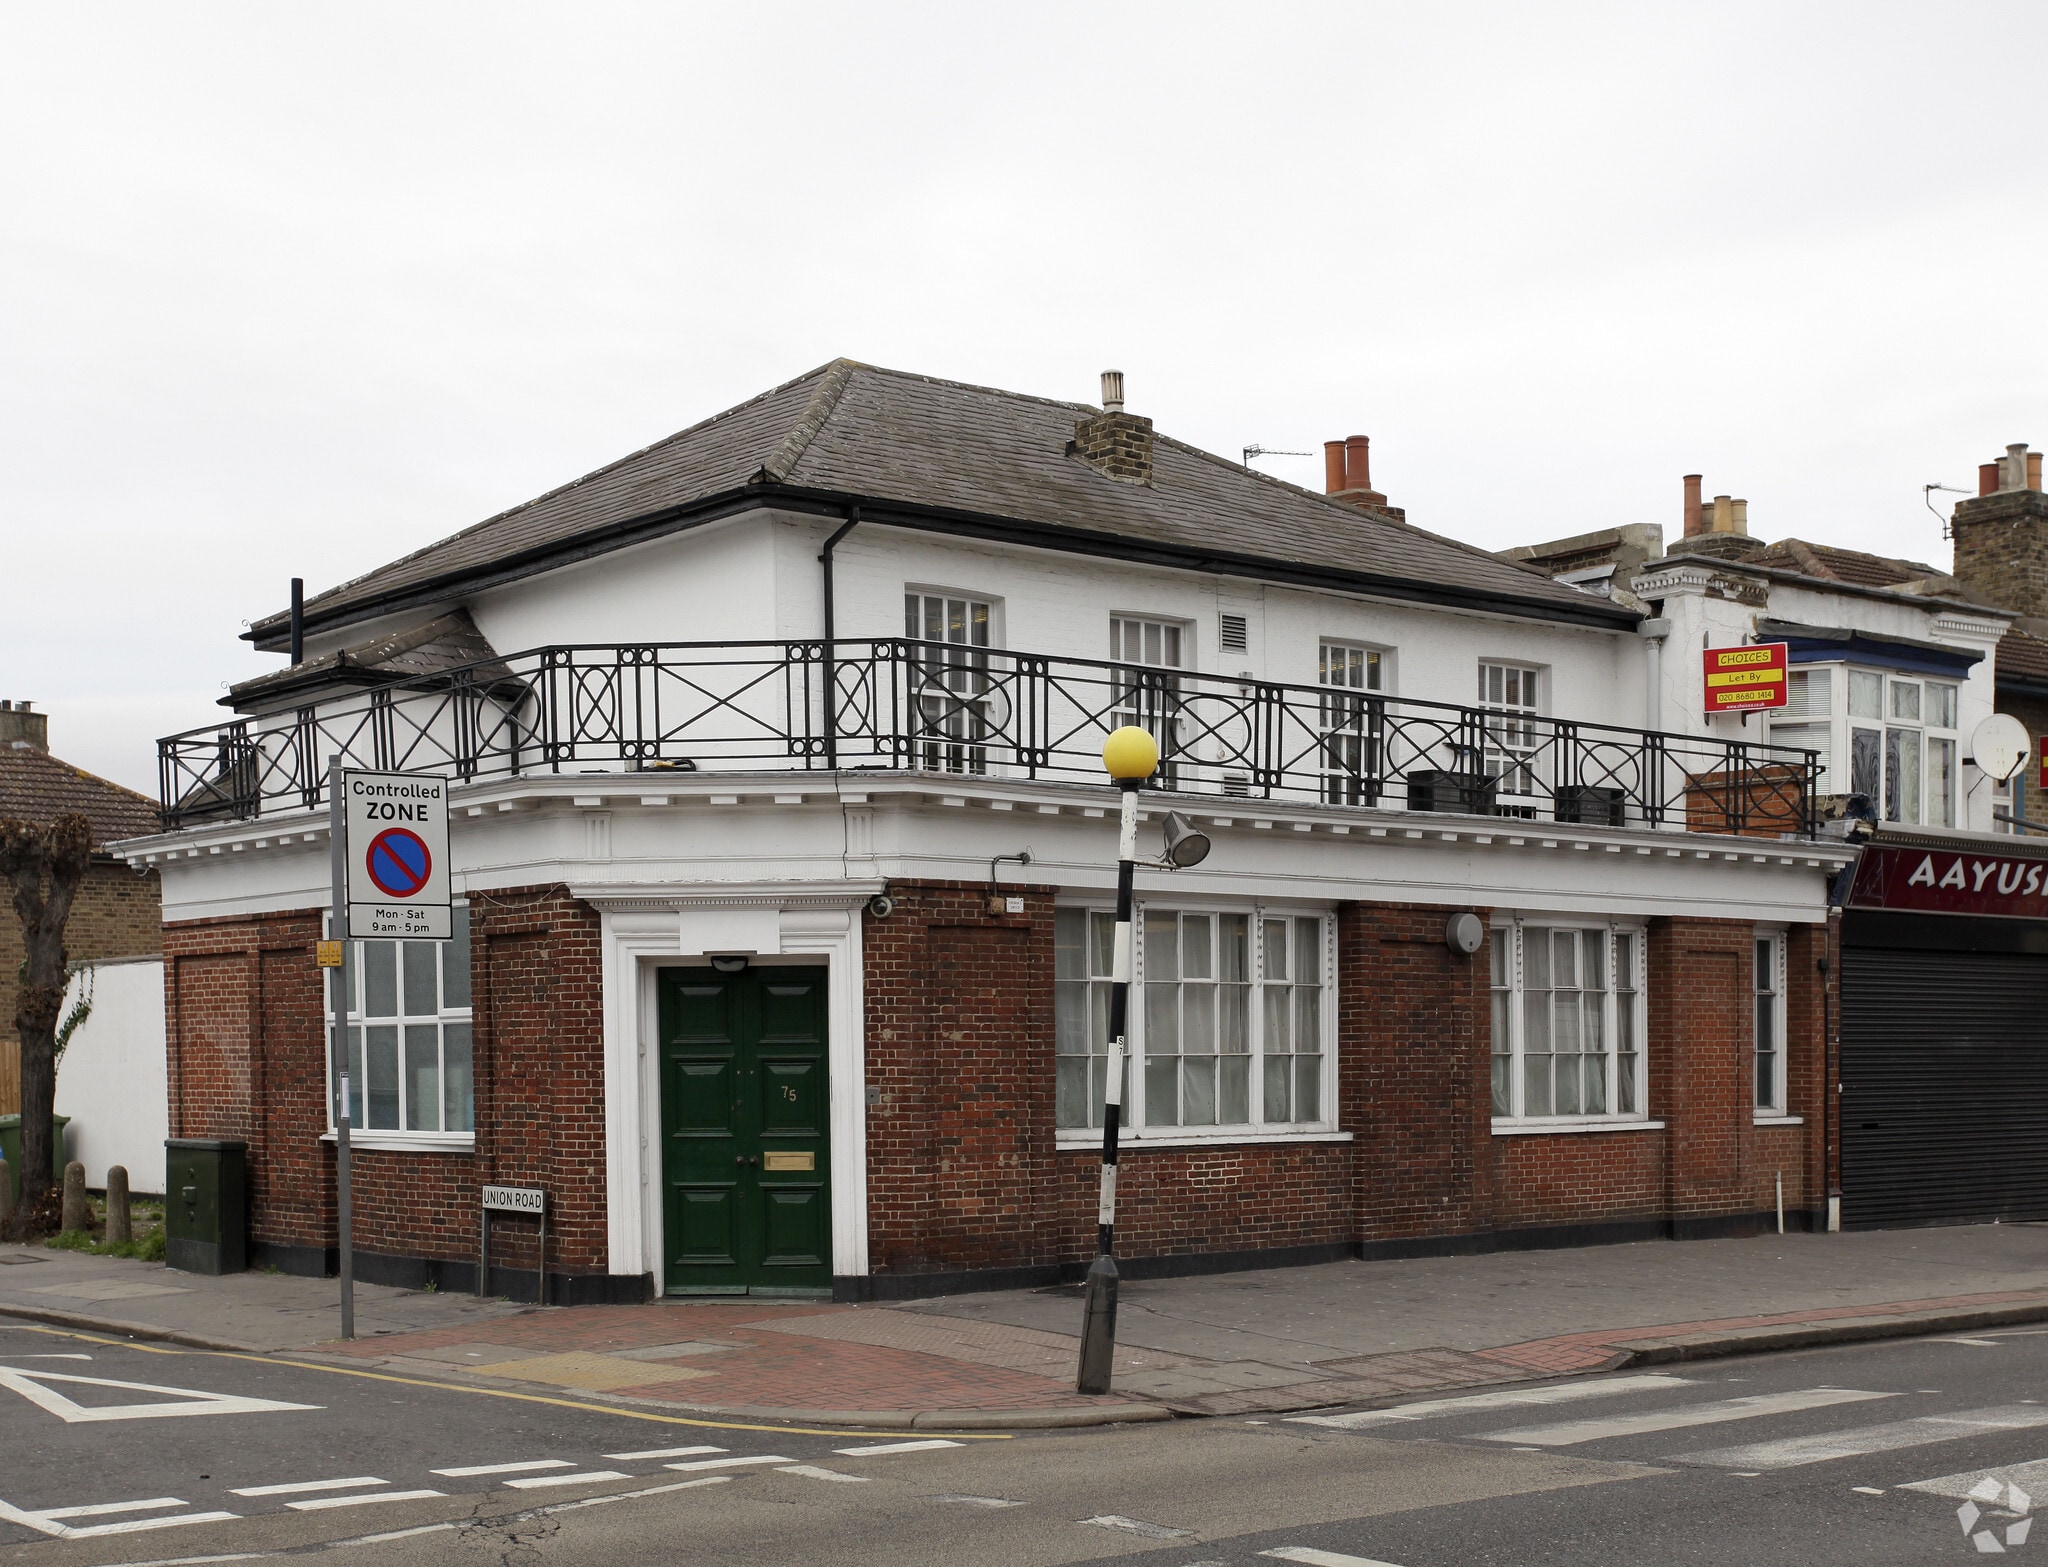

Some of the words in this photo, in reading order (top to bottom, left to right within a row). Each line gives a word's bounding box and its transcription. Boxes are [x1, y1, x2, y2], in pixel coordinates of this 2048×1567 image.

[1720, 652, 1769, 664] CHOICES
[1728, 674, 1745, 683] Let
[1749, 672, 1761, 682] By
[1718, 693, 1734, 702] 020
[1735, 692, 1754, 700] 8680
[1757, 690, 1772, 699] 1414
[352, 780, 441, 799] Controlled
[366, 801, 429, 822] ZONE
[1908, 855, 2048, 896] AAYUS
[375, 908, 399, 919] Mon
[406, 909, 425, 920] Sat
[781, 1085, 797, 1102] 75
[483, 1190, 513, 1206] UNION
[515, 1192, 542, 1208] ROAD
